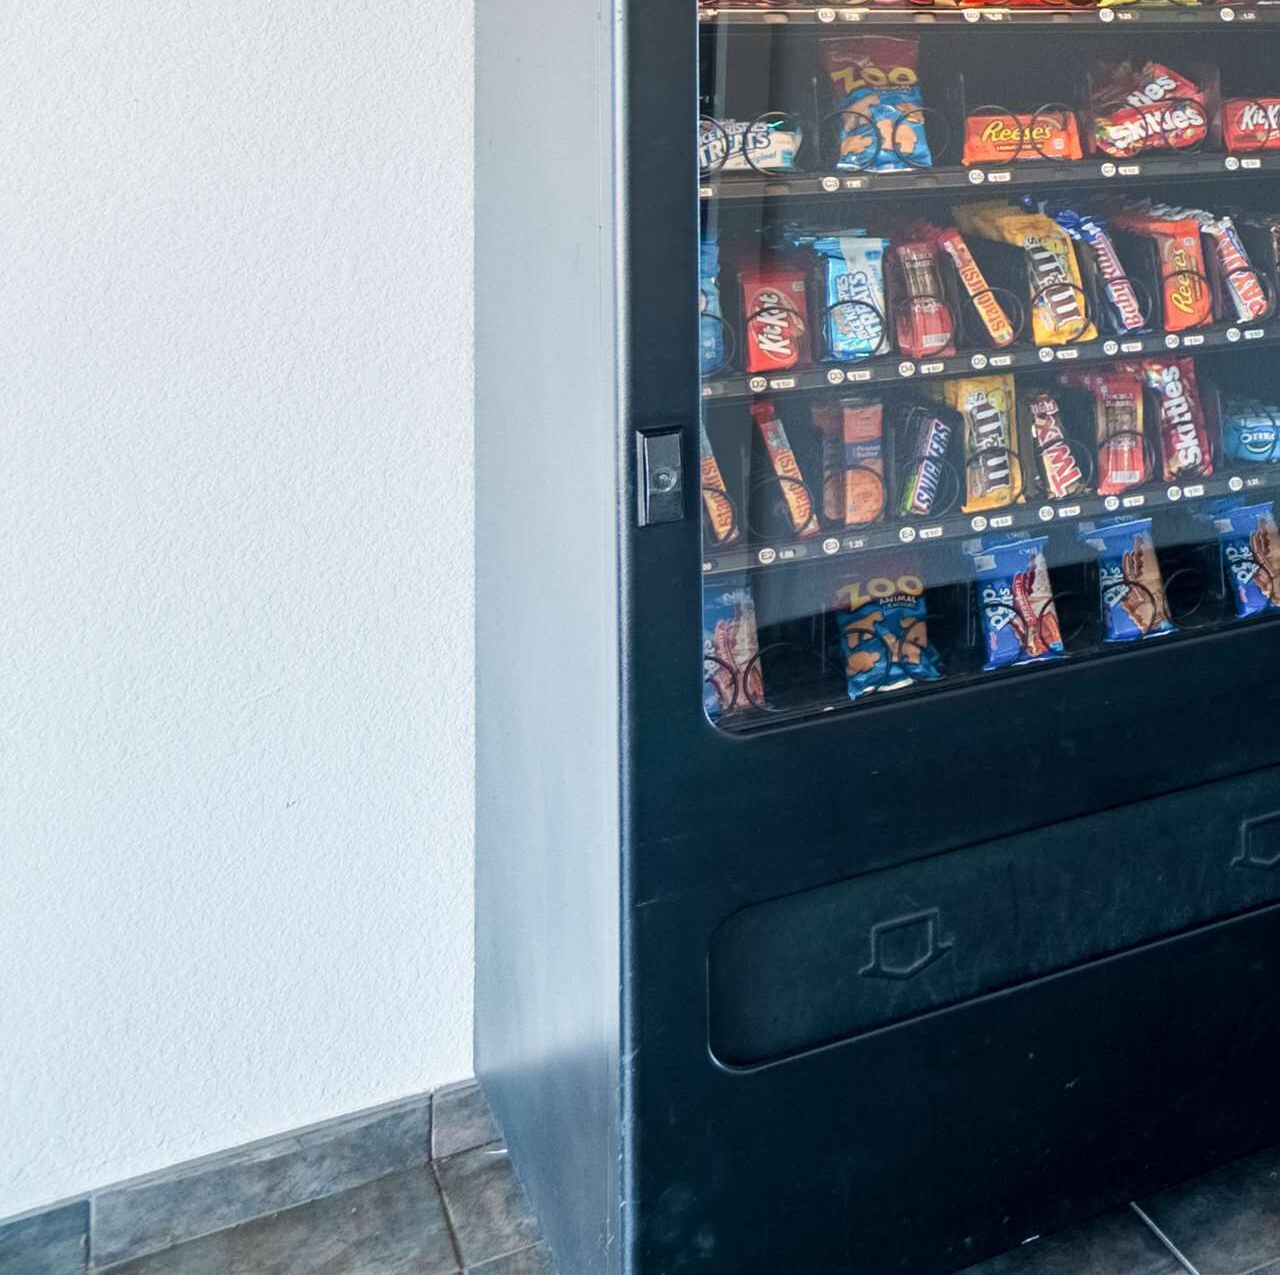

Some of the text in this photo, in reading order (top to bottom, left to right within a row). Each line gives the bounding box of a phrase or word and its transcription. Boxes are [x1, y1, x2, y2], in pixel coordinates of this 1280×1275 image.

[831, 67, 917, 94] ZOO
[751, 379, 766, 389] D2
[1160, 365, 1201, 468] Skittles
[760, 551, 773, 560] E2
[835, 575, 924, 612] ZOO
